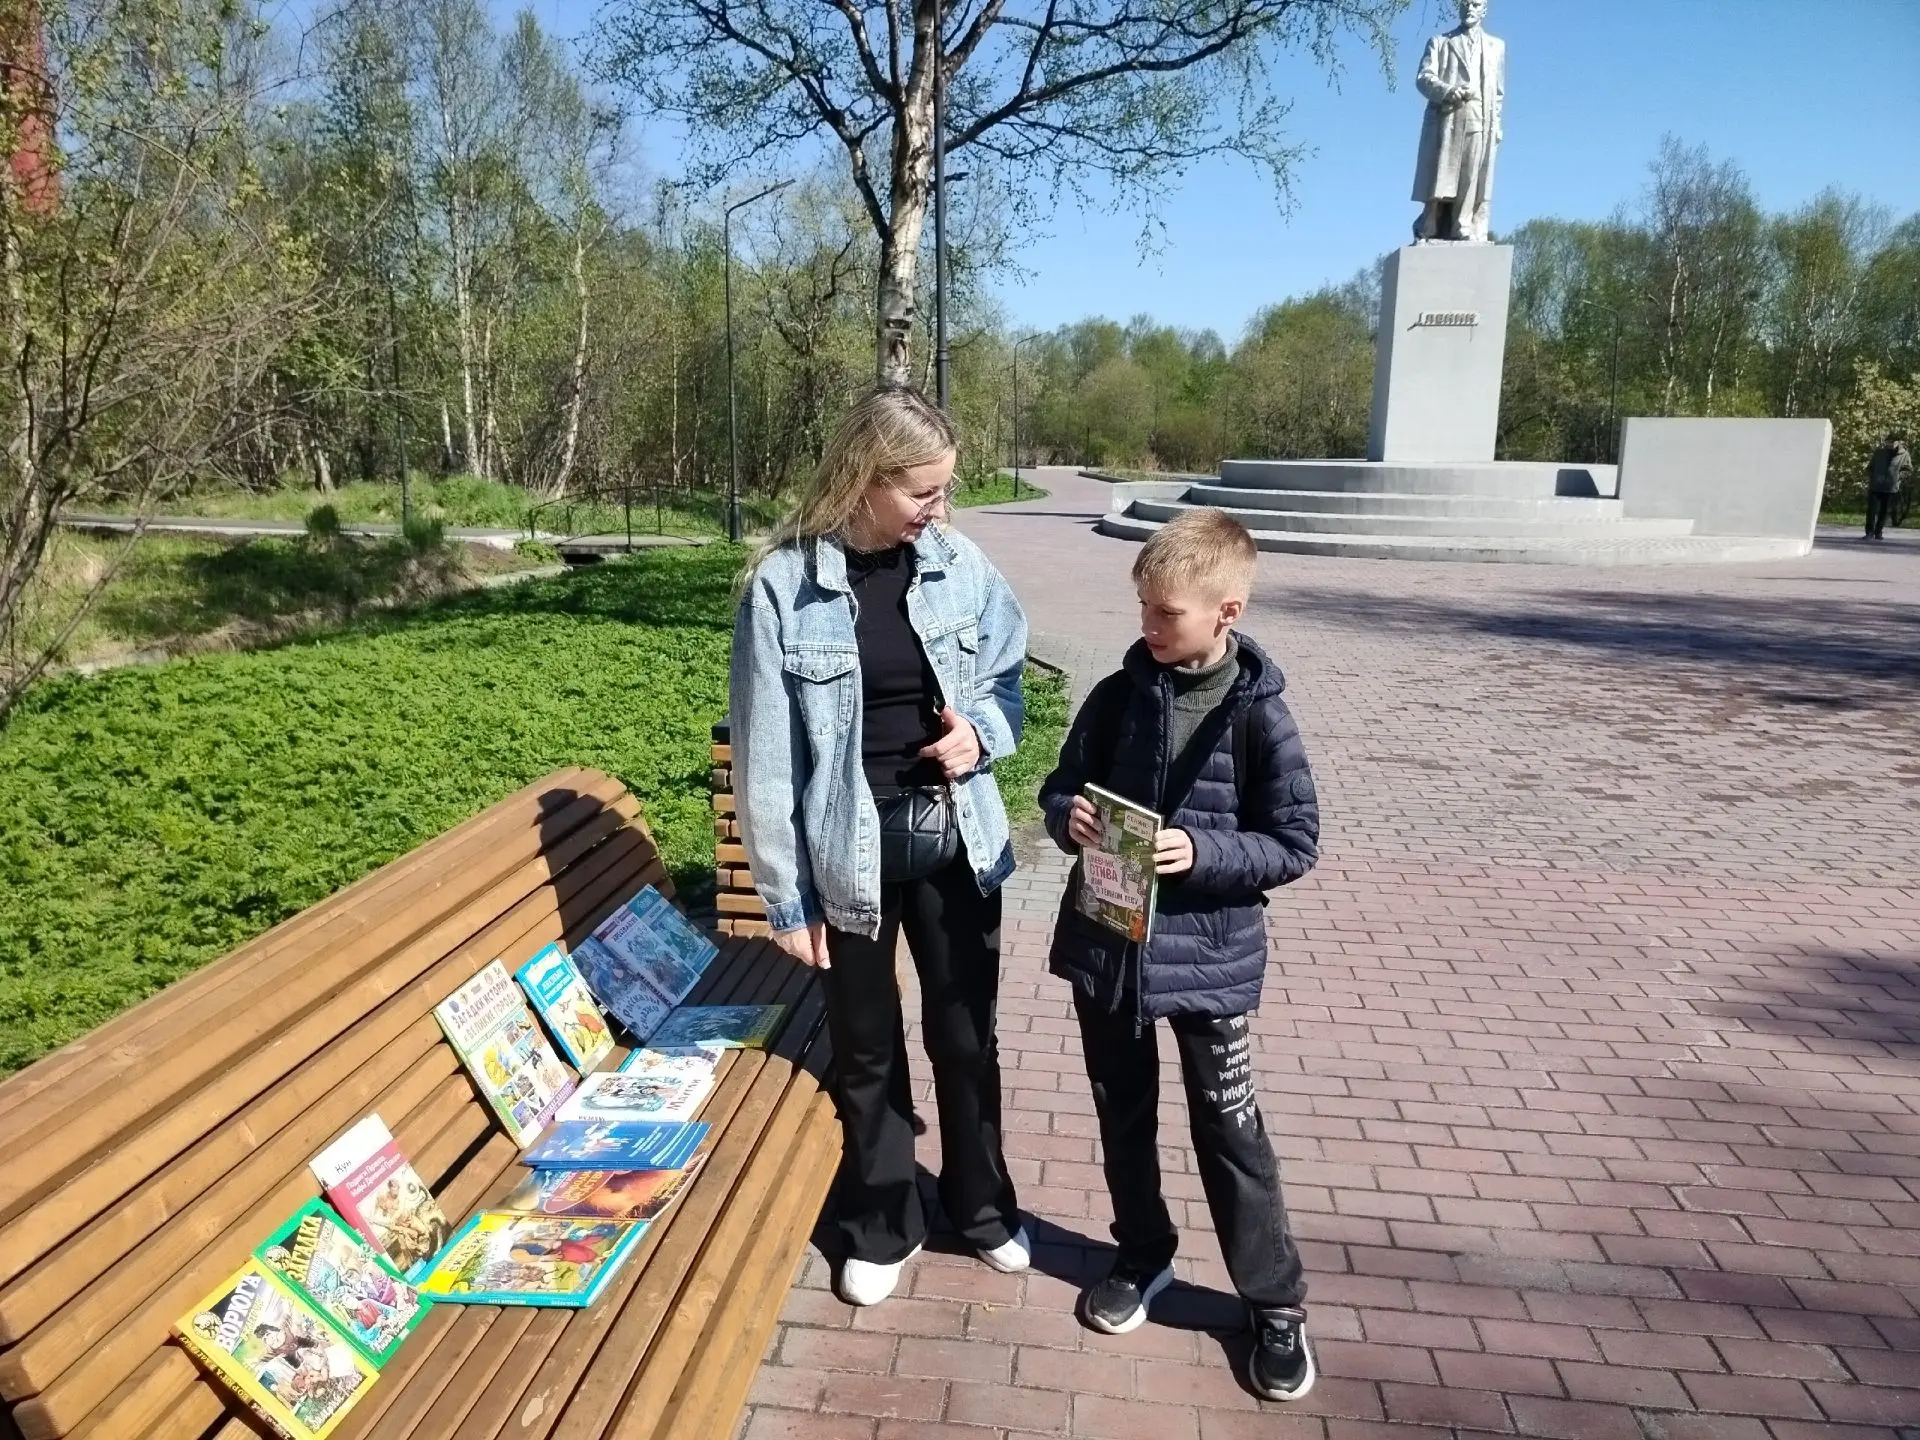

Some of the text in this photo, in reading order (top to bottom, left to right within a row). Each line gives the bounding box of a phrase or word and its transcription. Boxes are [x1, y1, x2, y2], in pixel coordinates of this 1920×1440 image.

[1089, 864, 1118, 881] СТИВА
[1210, 1044, 1226, 1055] THE
[1222, 1081, 1247, 1102] WHAT
[286, 1215, 323, 1281] ЗАГАДКА
[217, 1273, 262, 1354] ВОРЮГА
